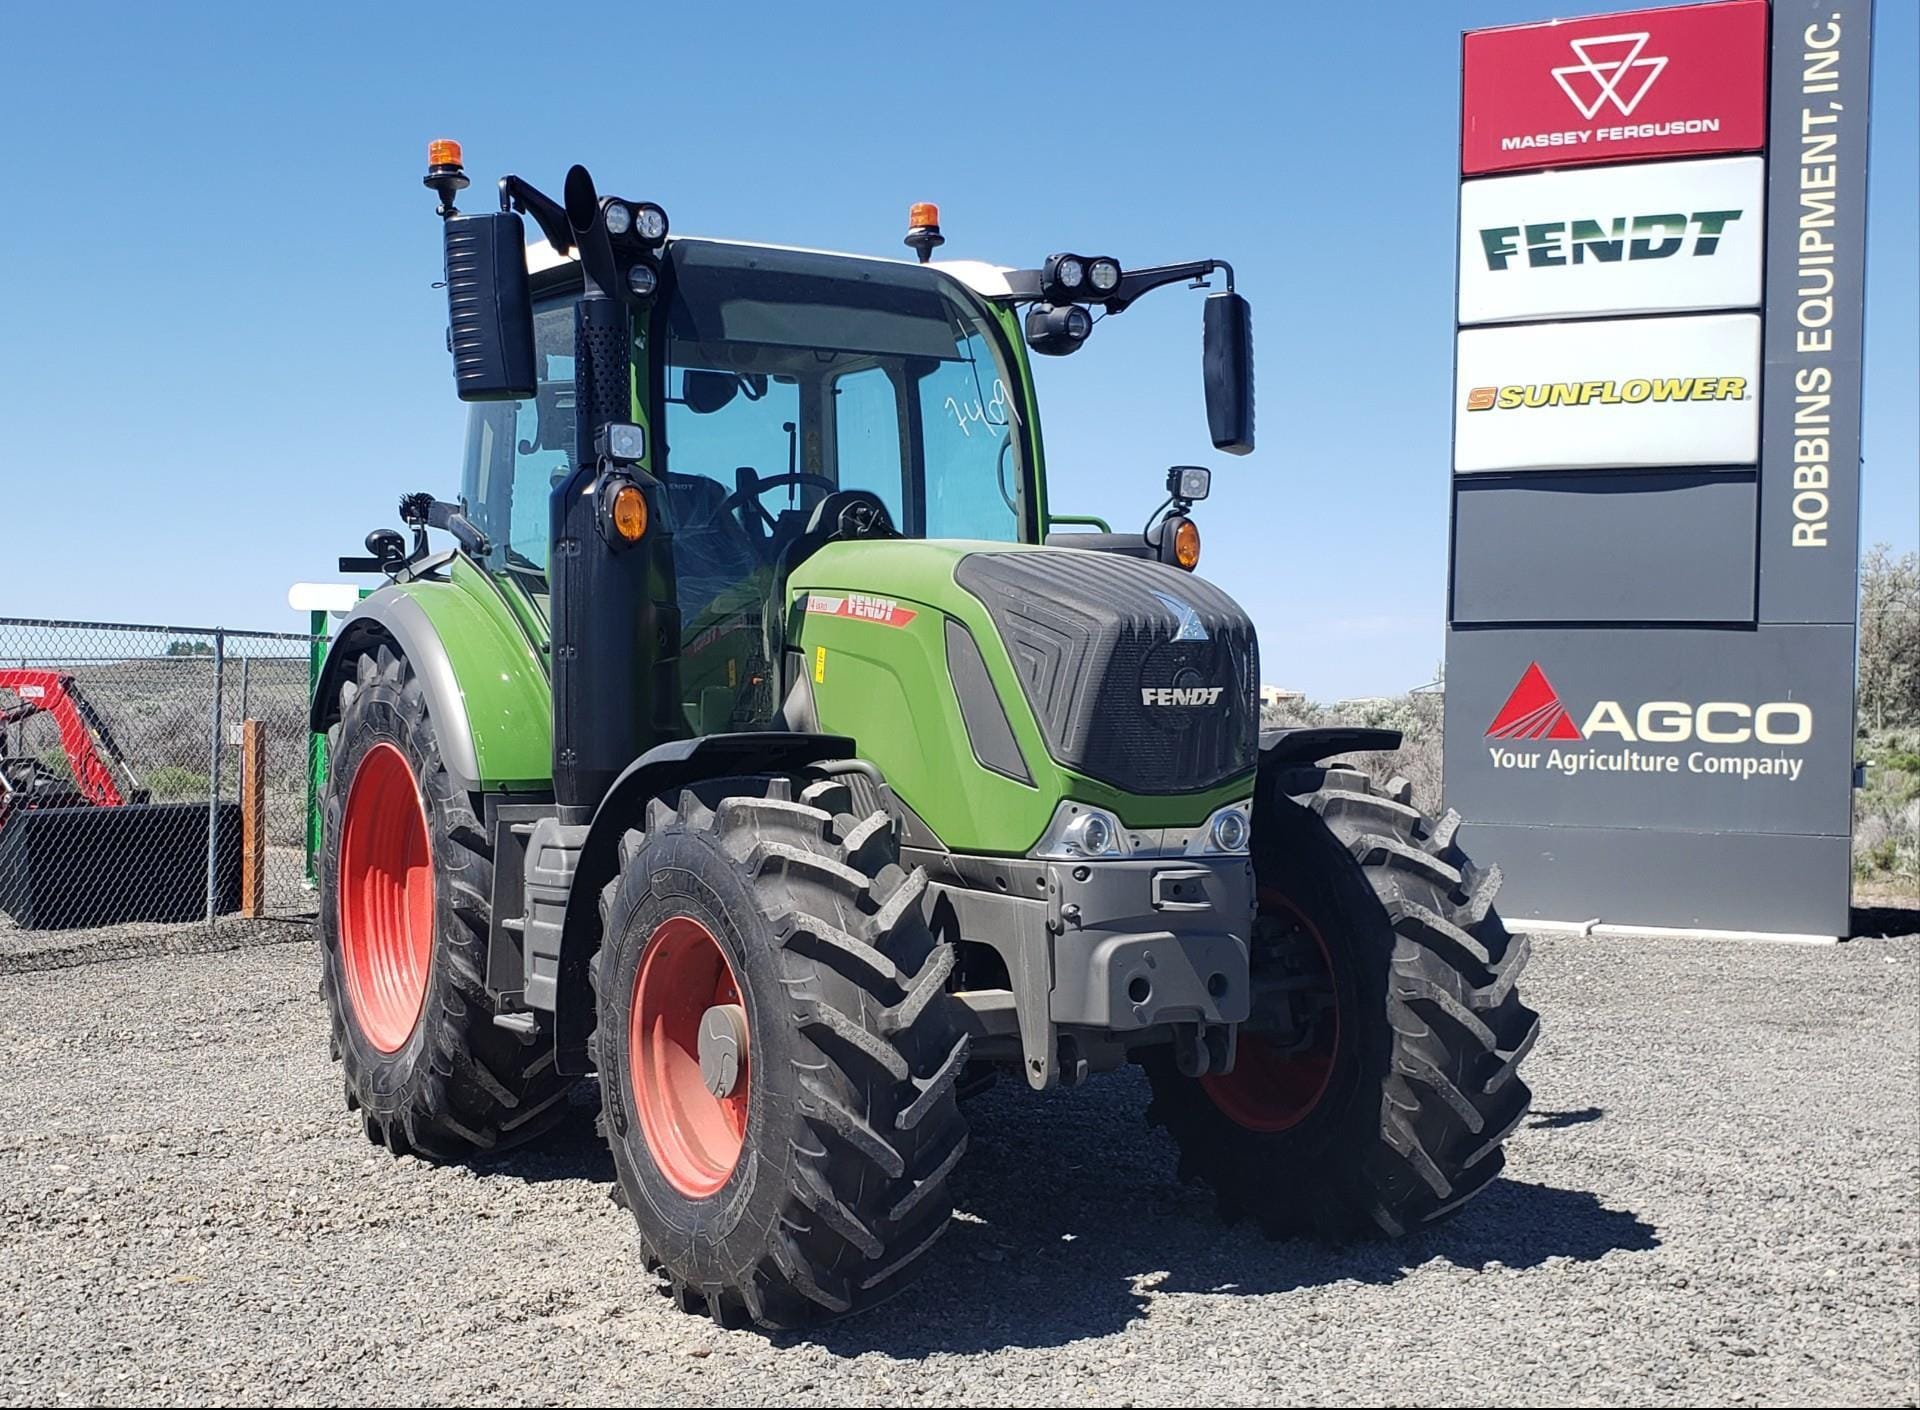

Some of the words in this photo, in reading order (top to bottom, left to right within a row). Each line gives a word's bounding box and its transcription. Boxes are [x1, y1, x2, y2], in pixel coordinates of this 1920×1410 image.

[1803, 12, 1841, 94] INC.
[1502, 130, 1593, 150] MASSEY
[1597, 119, 1719, 142] FERGUSON
[1480, 210, 1743, 271] FENDT
[1797, 102, 1843, 352] EQUIPMENT,
[1498, 377, 1746, 409] SUNFLOWER
[1792, 367, 1832, 546] ROBBINS
[847, 593, 897, 621] FENDT
[1141, 687, 1223, 706] FENDT
[1581, 700, 1813, 745] AGCO
[1489, 748, 1541, 769] Your
[1546, 749, 1680, 775] Agriculture
[1687, 752, 1804, 780] Company
